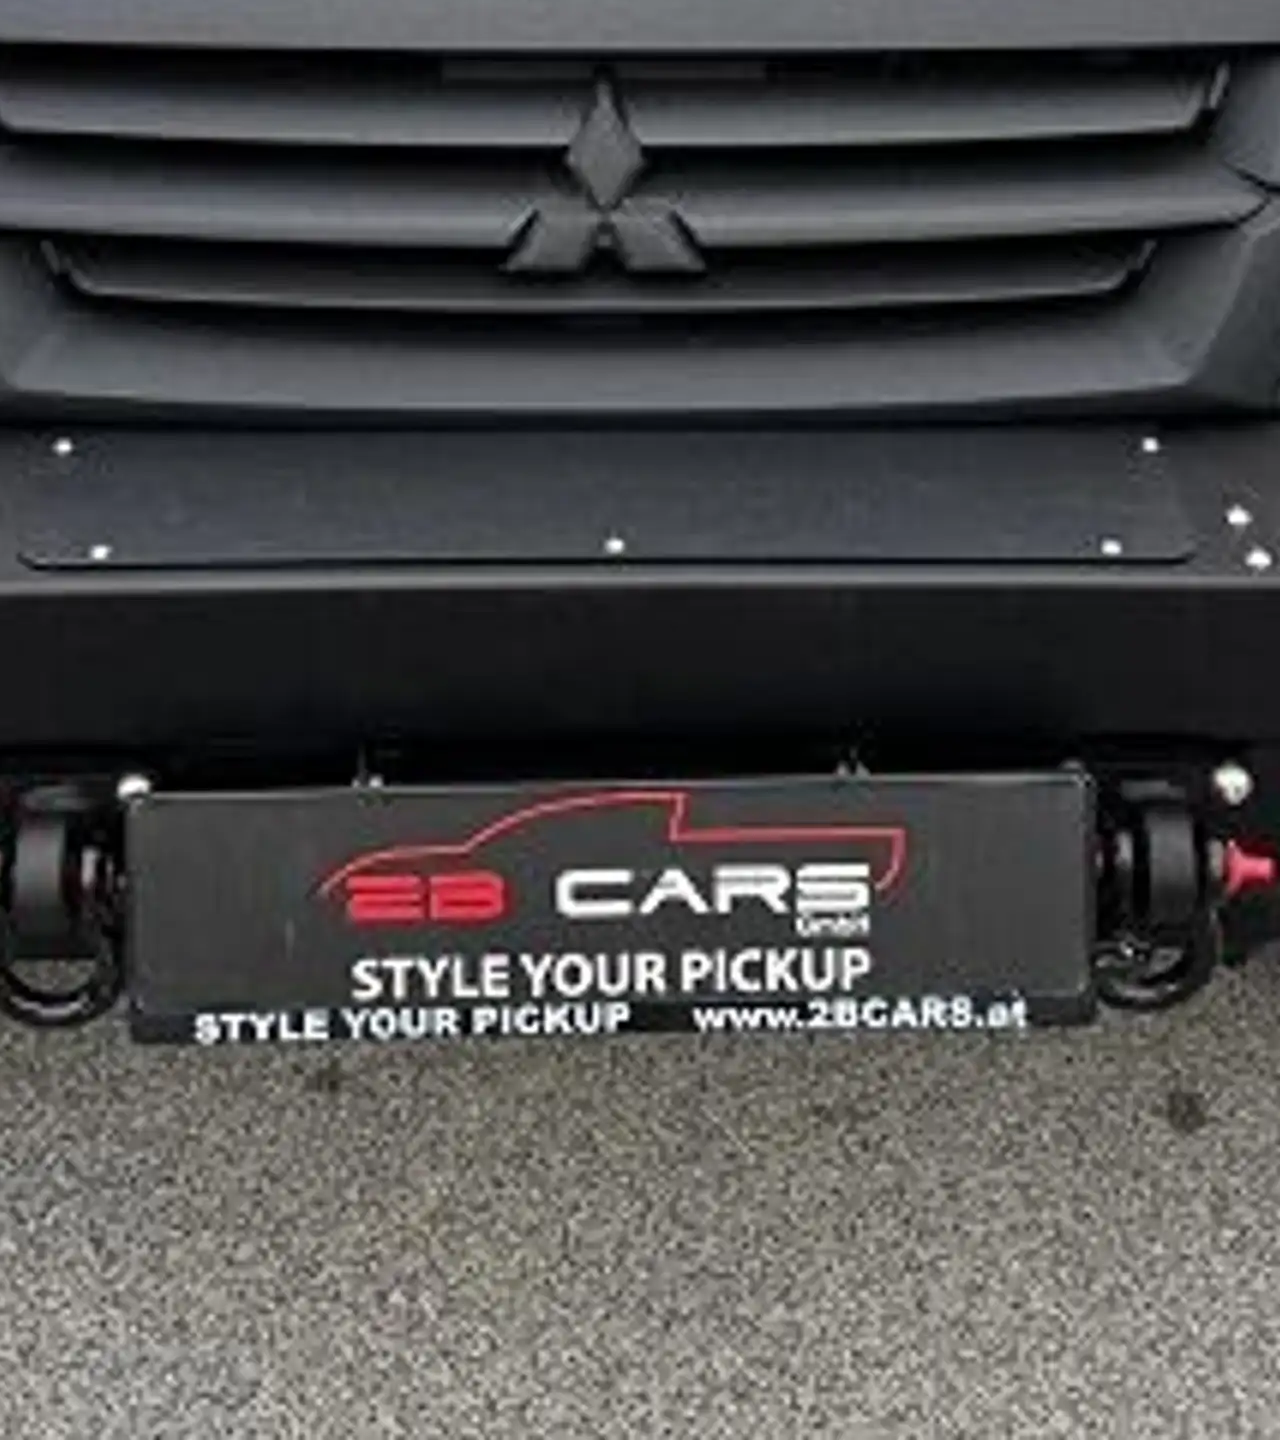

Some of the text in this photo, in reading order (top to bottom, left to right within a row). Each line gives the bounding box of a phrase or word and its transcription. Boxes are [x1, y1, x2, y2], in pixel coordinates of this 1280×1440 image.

[346, 863, 870, 922] 2B CARS
[351, 946, 871, 1000] STYLE YOUR PICKUP
[194, 993, 1028, 1044] STYLE YOUR PICKUP www.2BCARS.at
